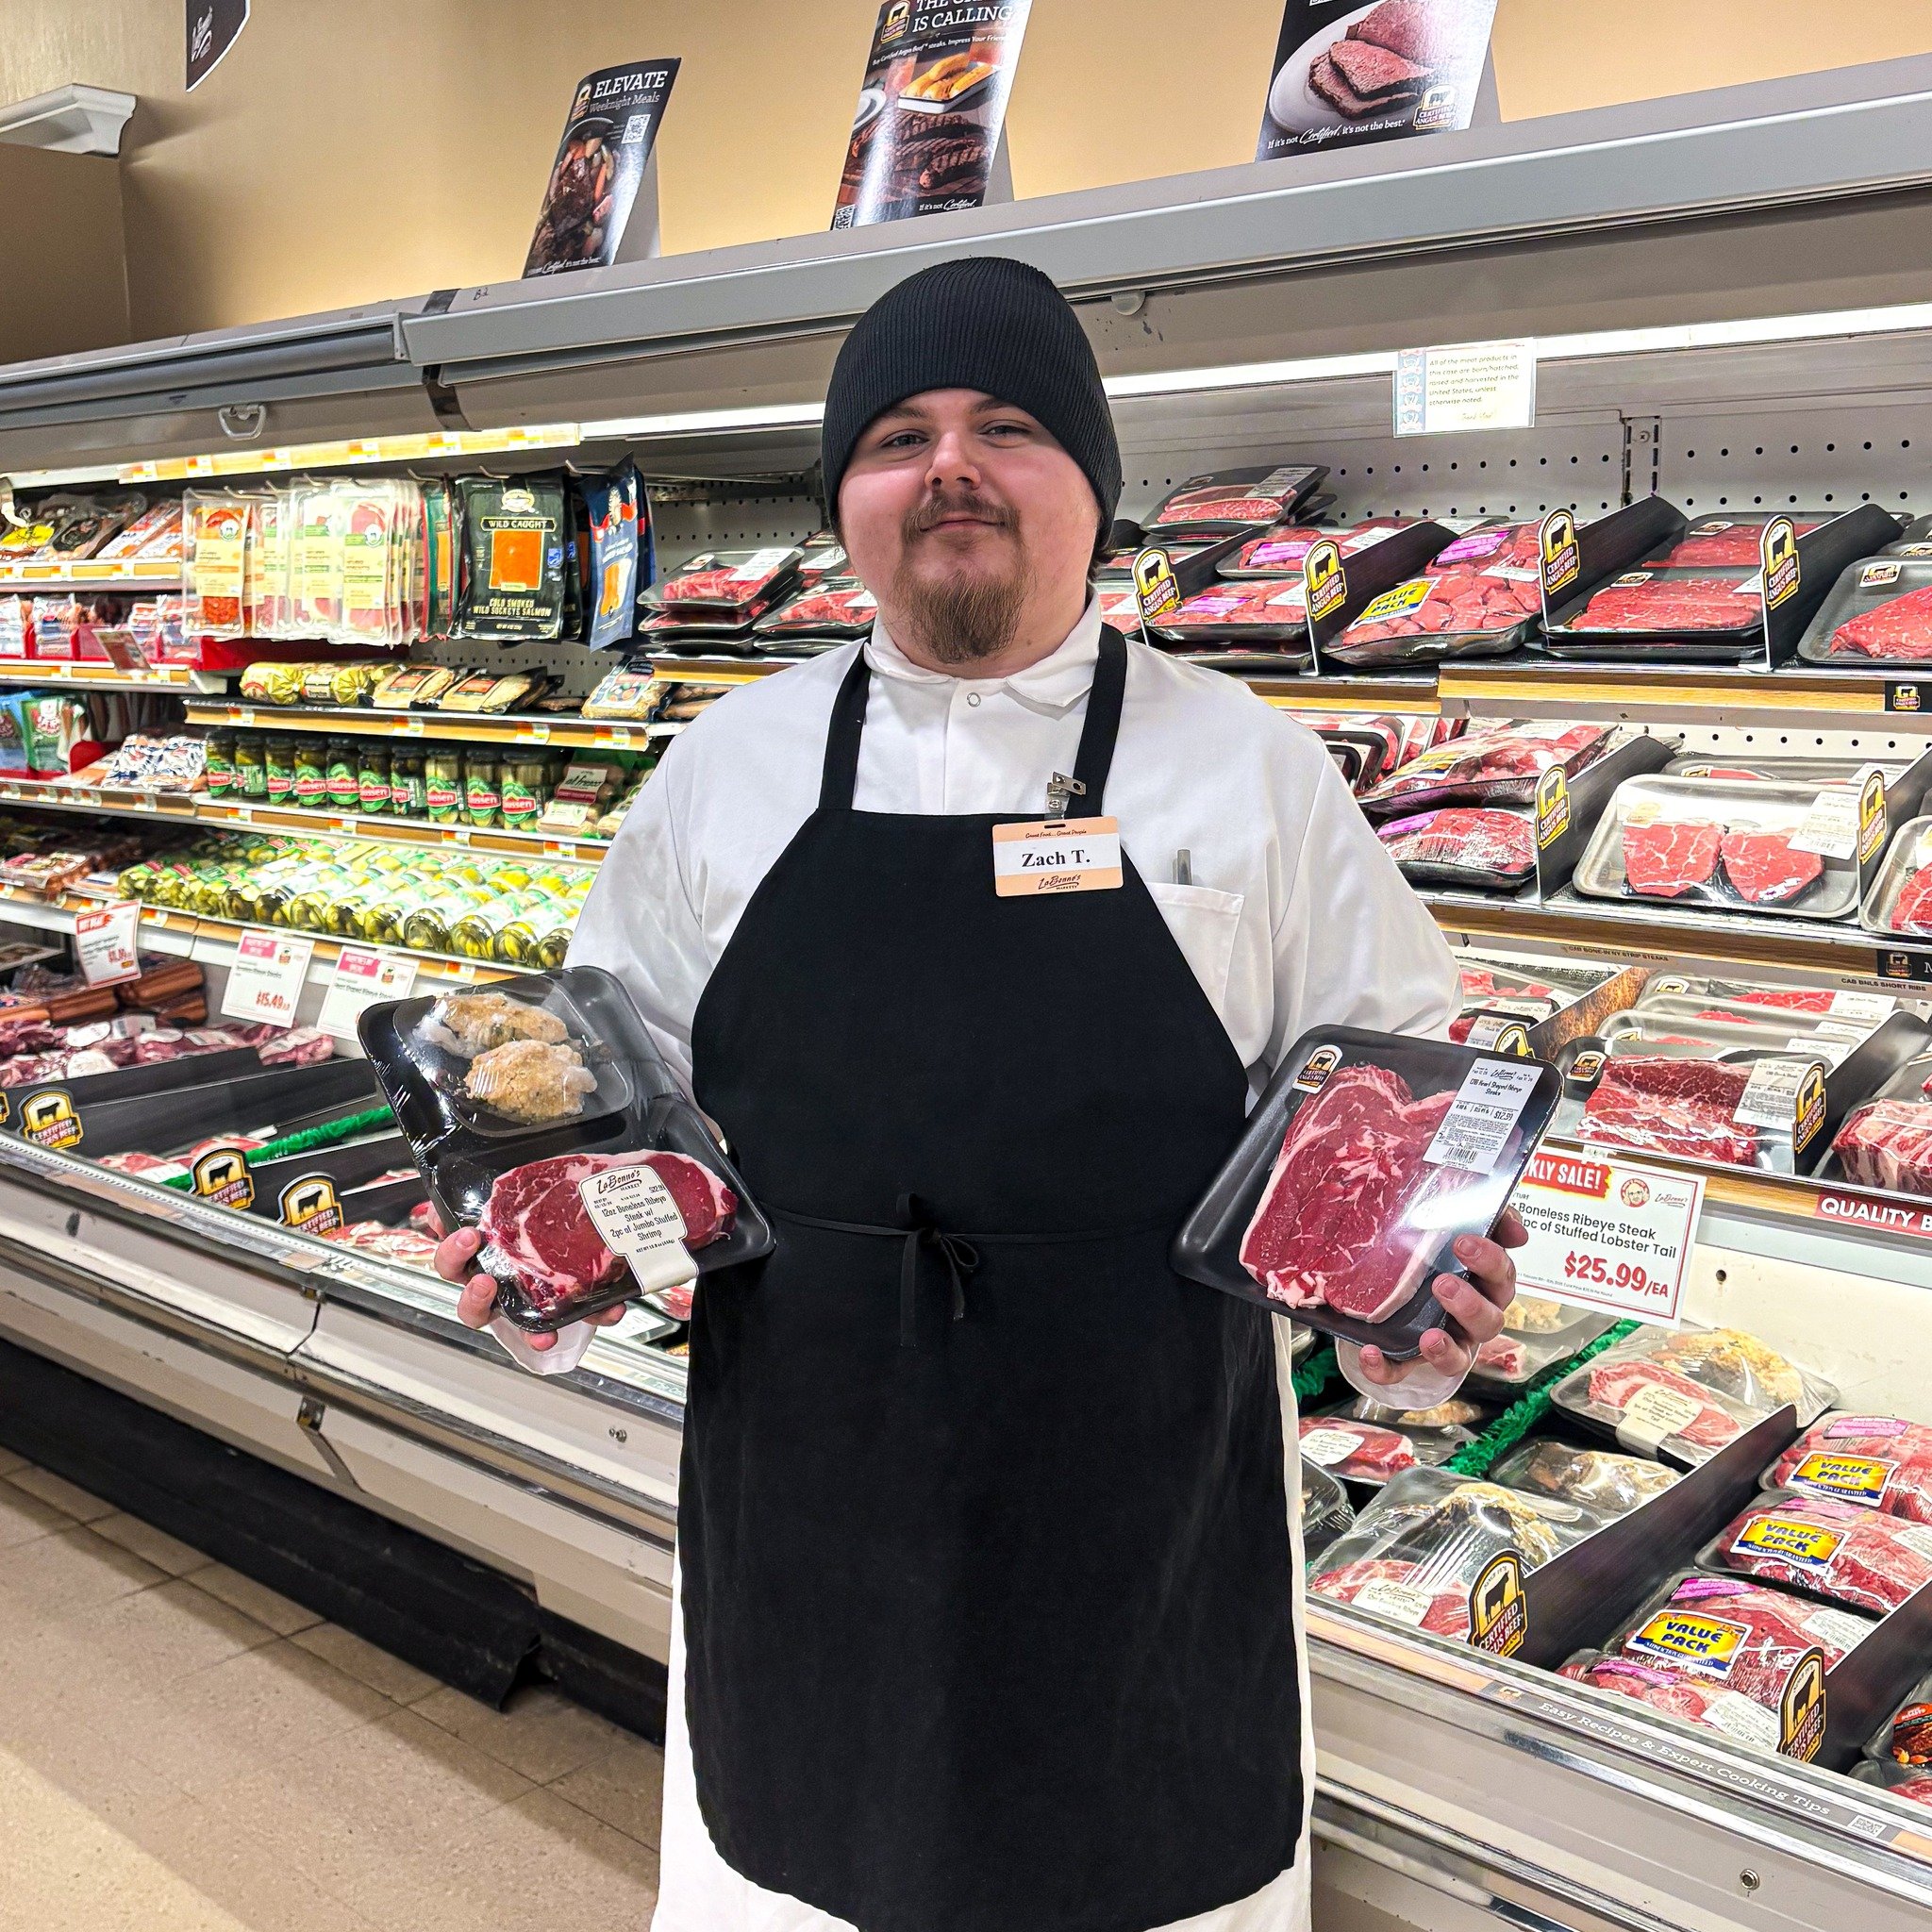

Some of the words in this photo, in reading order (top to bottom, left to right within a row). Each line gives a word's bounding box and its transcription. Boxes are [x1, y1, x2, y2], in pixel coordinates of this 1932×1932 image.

[912, 16, 927, 32] IS
[931, 6, 1013, 28] CALLING
[592, 71, 669, 99] ELEVATE
[589, 96, 632, 113] Weeknight
[632, 92, 660, 105] Meals
[1267, 140, 1274, 149] If
[1274, 138, 1285, 146] it's
[1286, 136, 1298, 144] not
[1341, 125, 1354, 135] it's
[1355, 125, 1368, 133] not
[1370, 121, 1383, 130] the
[488, 520, 509, 528] WILD
[510, 520, 547, 528] CAUGHT
[1547, 546, 1574, 575] CERTIFIED
[1547, 566, 1564, 586] ANGUS
[1564, 556, 1576, 572] BEEF
[1769, 558, 1794, 588] CERTIFIED
[1143, 579, 1172, 606] CERTIFIED
[1312, 574, 1340, 603] CERTIFIED
[1768, 578, 1786, 600] ANGUS
[1785, 568, 1797, 584] BEEF
[507, 598, 535, 608] SMOKED
[1144, 600, 1162, 616] ANGUS
[1162, 587, 1175, 602] BEEF
[1311, 593, 1330, 613] ANGUS
[1330, 583, 1343, 598] BEEF
[473, 606, 490, 614] WILD
[522, 608, 552, 617] SALMON
[1540, 799, 1565, 830] CERTIFIED
[1540, 821, 1557, 841] ANGUS
[1022, 851, 1066, 867] Zach
[1071, 849, 1091, 864] T.
[1583, 947, 1610, 956] BONE-IN
[1642, 954, 1669, 962] STEAKS
[31, 1118, 73, 1141] CERTIFIED
[597, 1169, 641, 1194] LaBonne's
[1523, 1158, 1556, 1181] KLY
[1557, 1161, 1603, 1191] SALE!
[209, 1179, 244, 1200] RTIFIED
[616, 1201, 645, 1214] Boneless
[644, 1195, 667, 1208] Ribeye
[625, 1211, 643, 1223] Steak
[644, 1208, 654, 1218] w/
[1821, 1196, 1916, 1228] QUALITY
[299, 1209, 334, 1230] RTIFIED
[610, 1227, 624, 1239] 2pc
[624, 1224, 632, 1234] of
[632, 1219, 655, 1232] Jumbo
[655, 1211, 678, 1226] Stuffed
[1518, 1202, 1571, 1223] Boneless
[1573, 1212, 1616, 1233] Ribeye
[1618, 1223, 1657, 1241] Steak
[637, 1228, 662, 1241] Shrimp
[1540, 1220, 1551, 1232] of
[1555, 1224, 1598, 1242] Stuffed
[1601, 1232, 1650, 1253] Lobster
[1653, 1242, 1677, 1259] Tail
[1817, 1471, 1862, 1486] PACK
[1821, 1461, 1874, 1474] VALUE
[1761, 1535, 1809, 1553] PACK
[1765, 1524, 1822, 1543] VALUE
[1479, 1602, 1518, 1650] CERTIFIED
[1504, 1614, 1522, 1641] BEEF
[1666, 1622, 1724, 1643] VALUE
[1661, 1633, 1711, 1654] PACK
[1786, 1703, 1820, 1757] CERTIFIED
[1538, 1702, 1576, 1721] Easy
[1577, 1716, 1640, 1744] Recipes
[1641, 1740, 1656, 1749] &
[1657, 1747, 1714, 1773] Expert
[1717, 1768, 1790, 1800] Cooking
[1792, 1793, 1830, 1816] Tips
